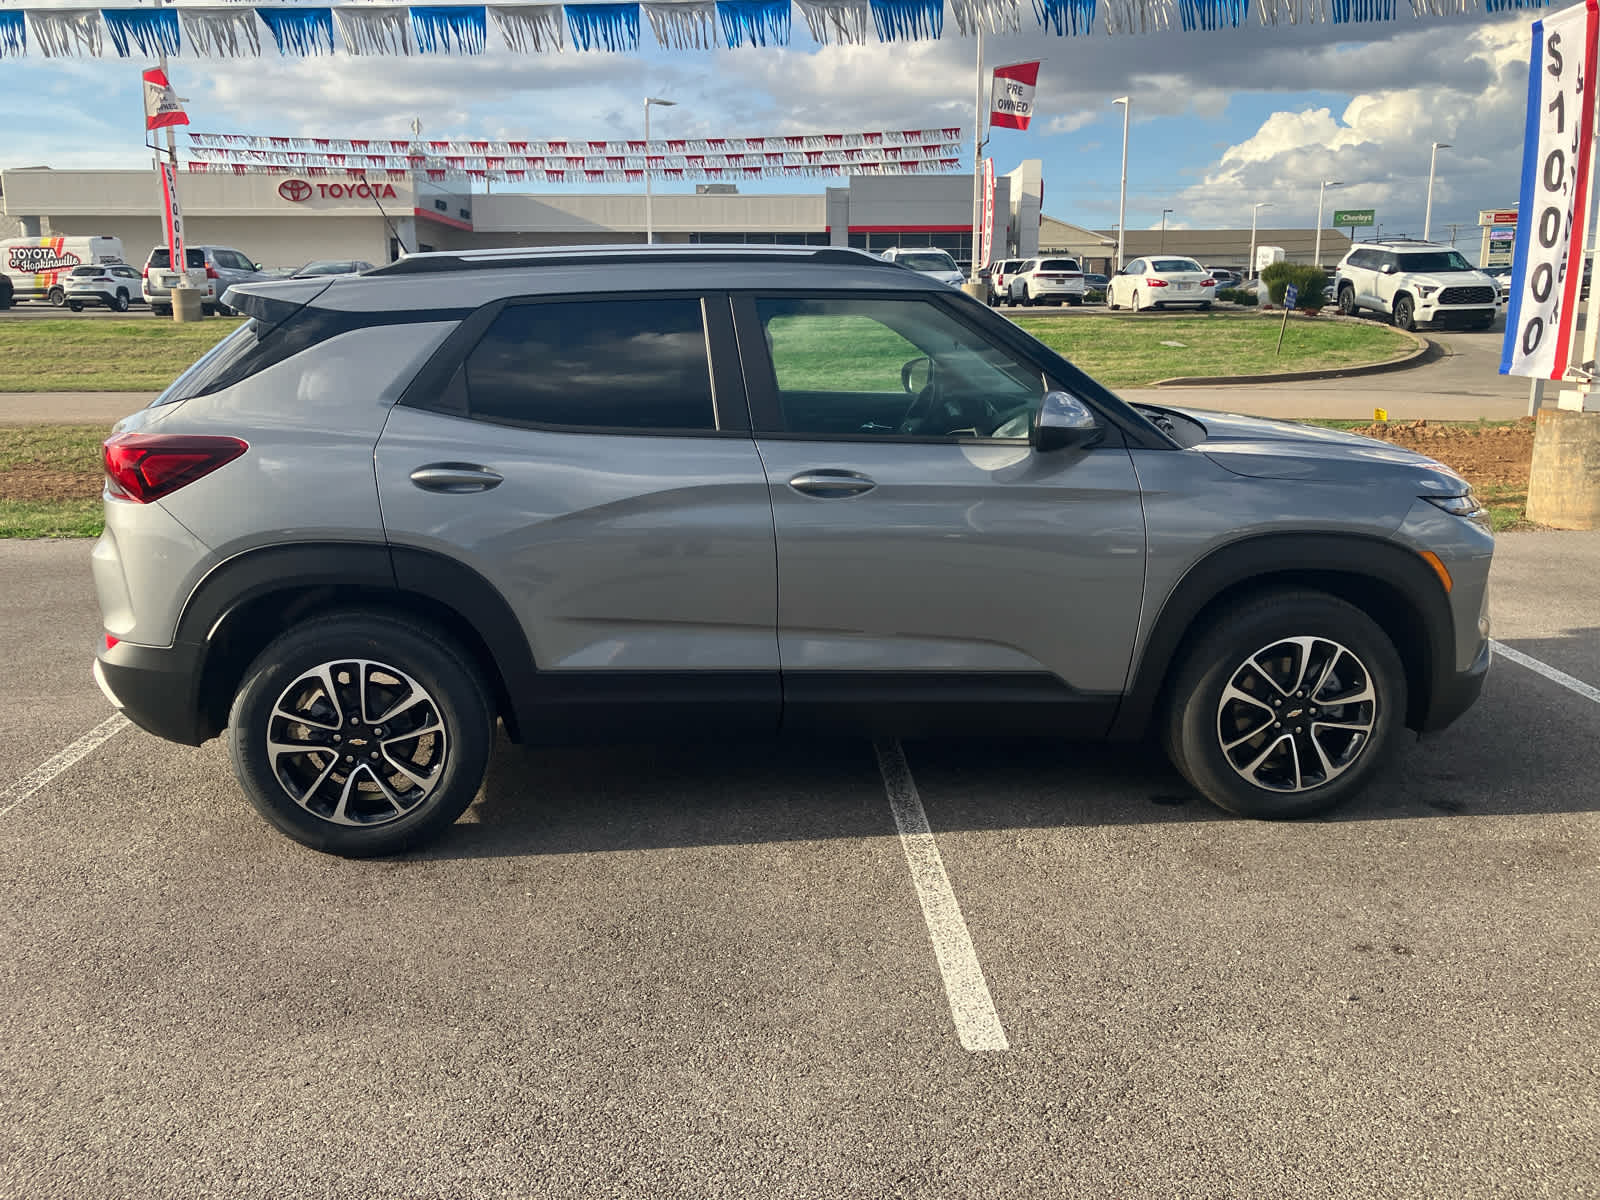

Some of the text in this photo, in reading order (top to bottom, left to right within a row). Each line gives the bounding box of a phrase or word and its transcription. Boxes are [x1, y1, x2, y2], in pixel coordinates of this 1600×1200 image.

[1006, 83, 1023, 96] PRE
[998, 99, 1028, 112] OWNED
[316, 183, 397, 199] TOYOTA
[10, 248, 57, 259] TOYOTA
[20, 254, 79, 272] Hopkinsville
